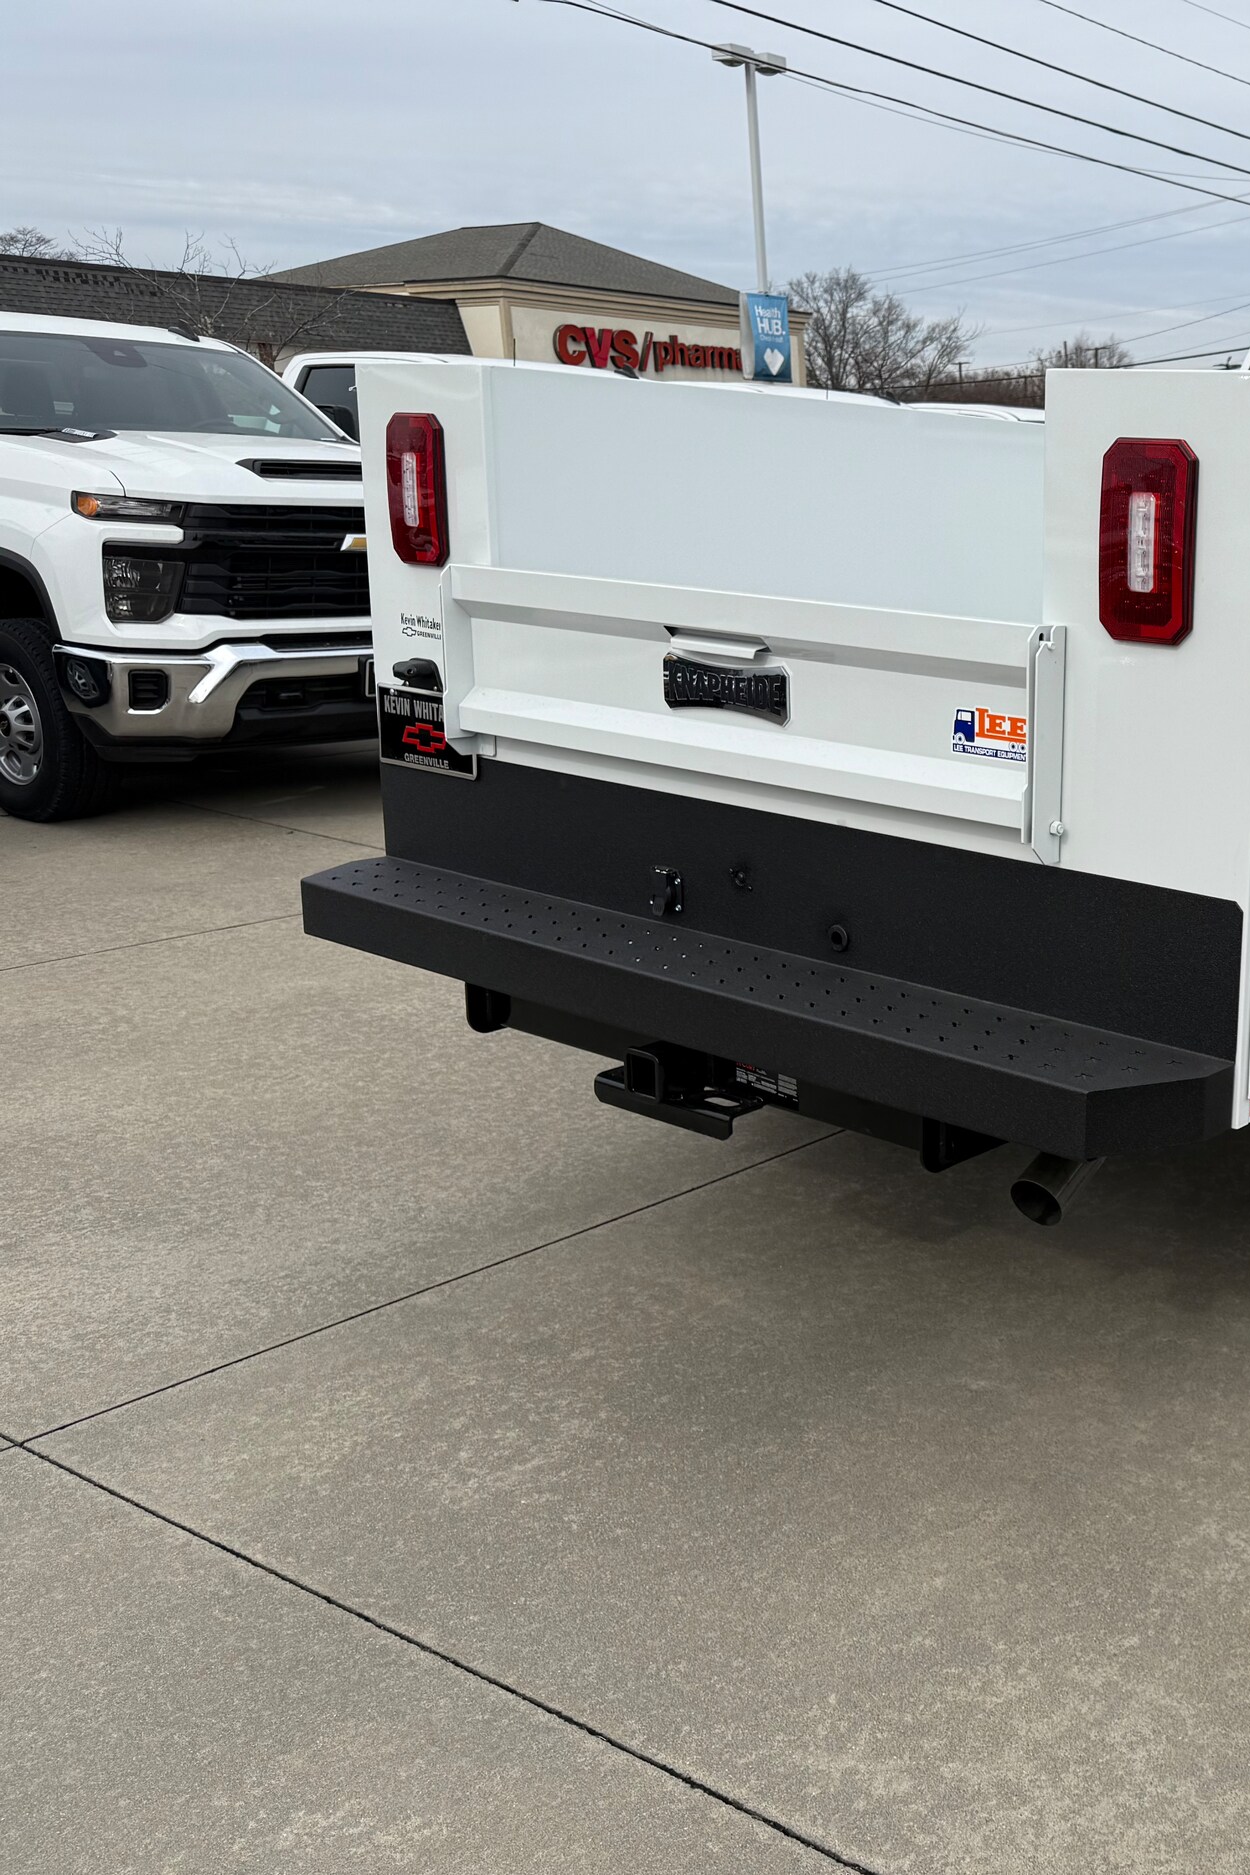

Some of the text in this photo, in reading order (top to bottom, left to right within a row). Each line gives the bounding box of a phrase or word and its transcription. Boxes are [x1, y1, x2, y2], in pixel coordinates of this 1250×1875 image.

[754, 304, 781, 319] Health
[400, 612, 416, 627] Kevin
[666, 662, 782, 715] KNAPHEIDE
[384, 694, 411, 717] KEVIN
[976, 707, 1027, 744] LEE
[404, 752, 449, 770] GREENVILLE
[953, 744, 1027, 761] LEE TRANSPORT EQUIPMEN
